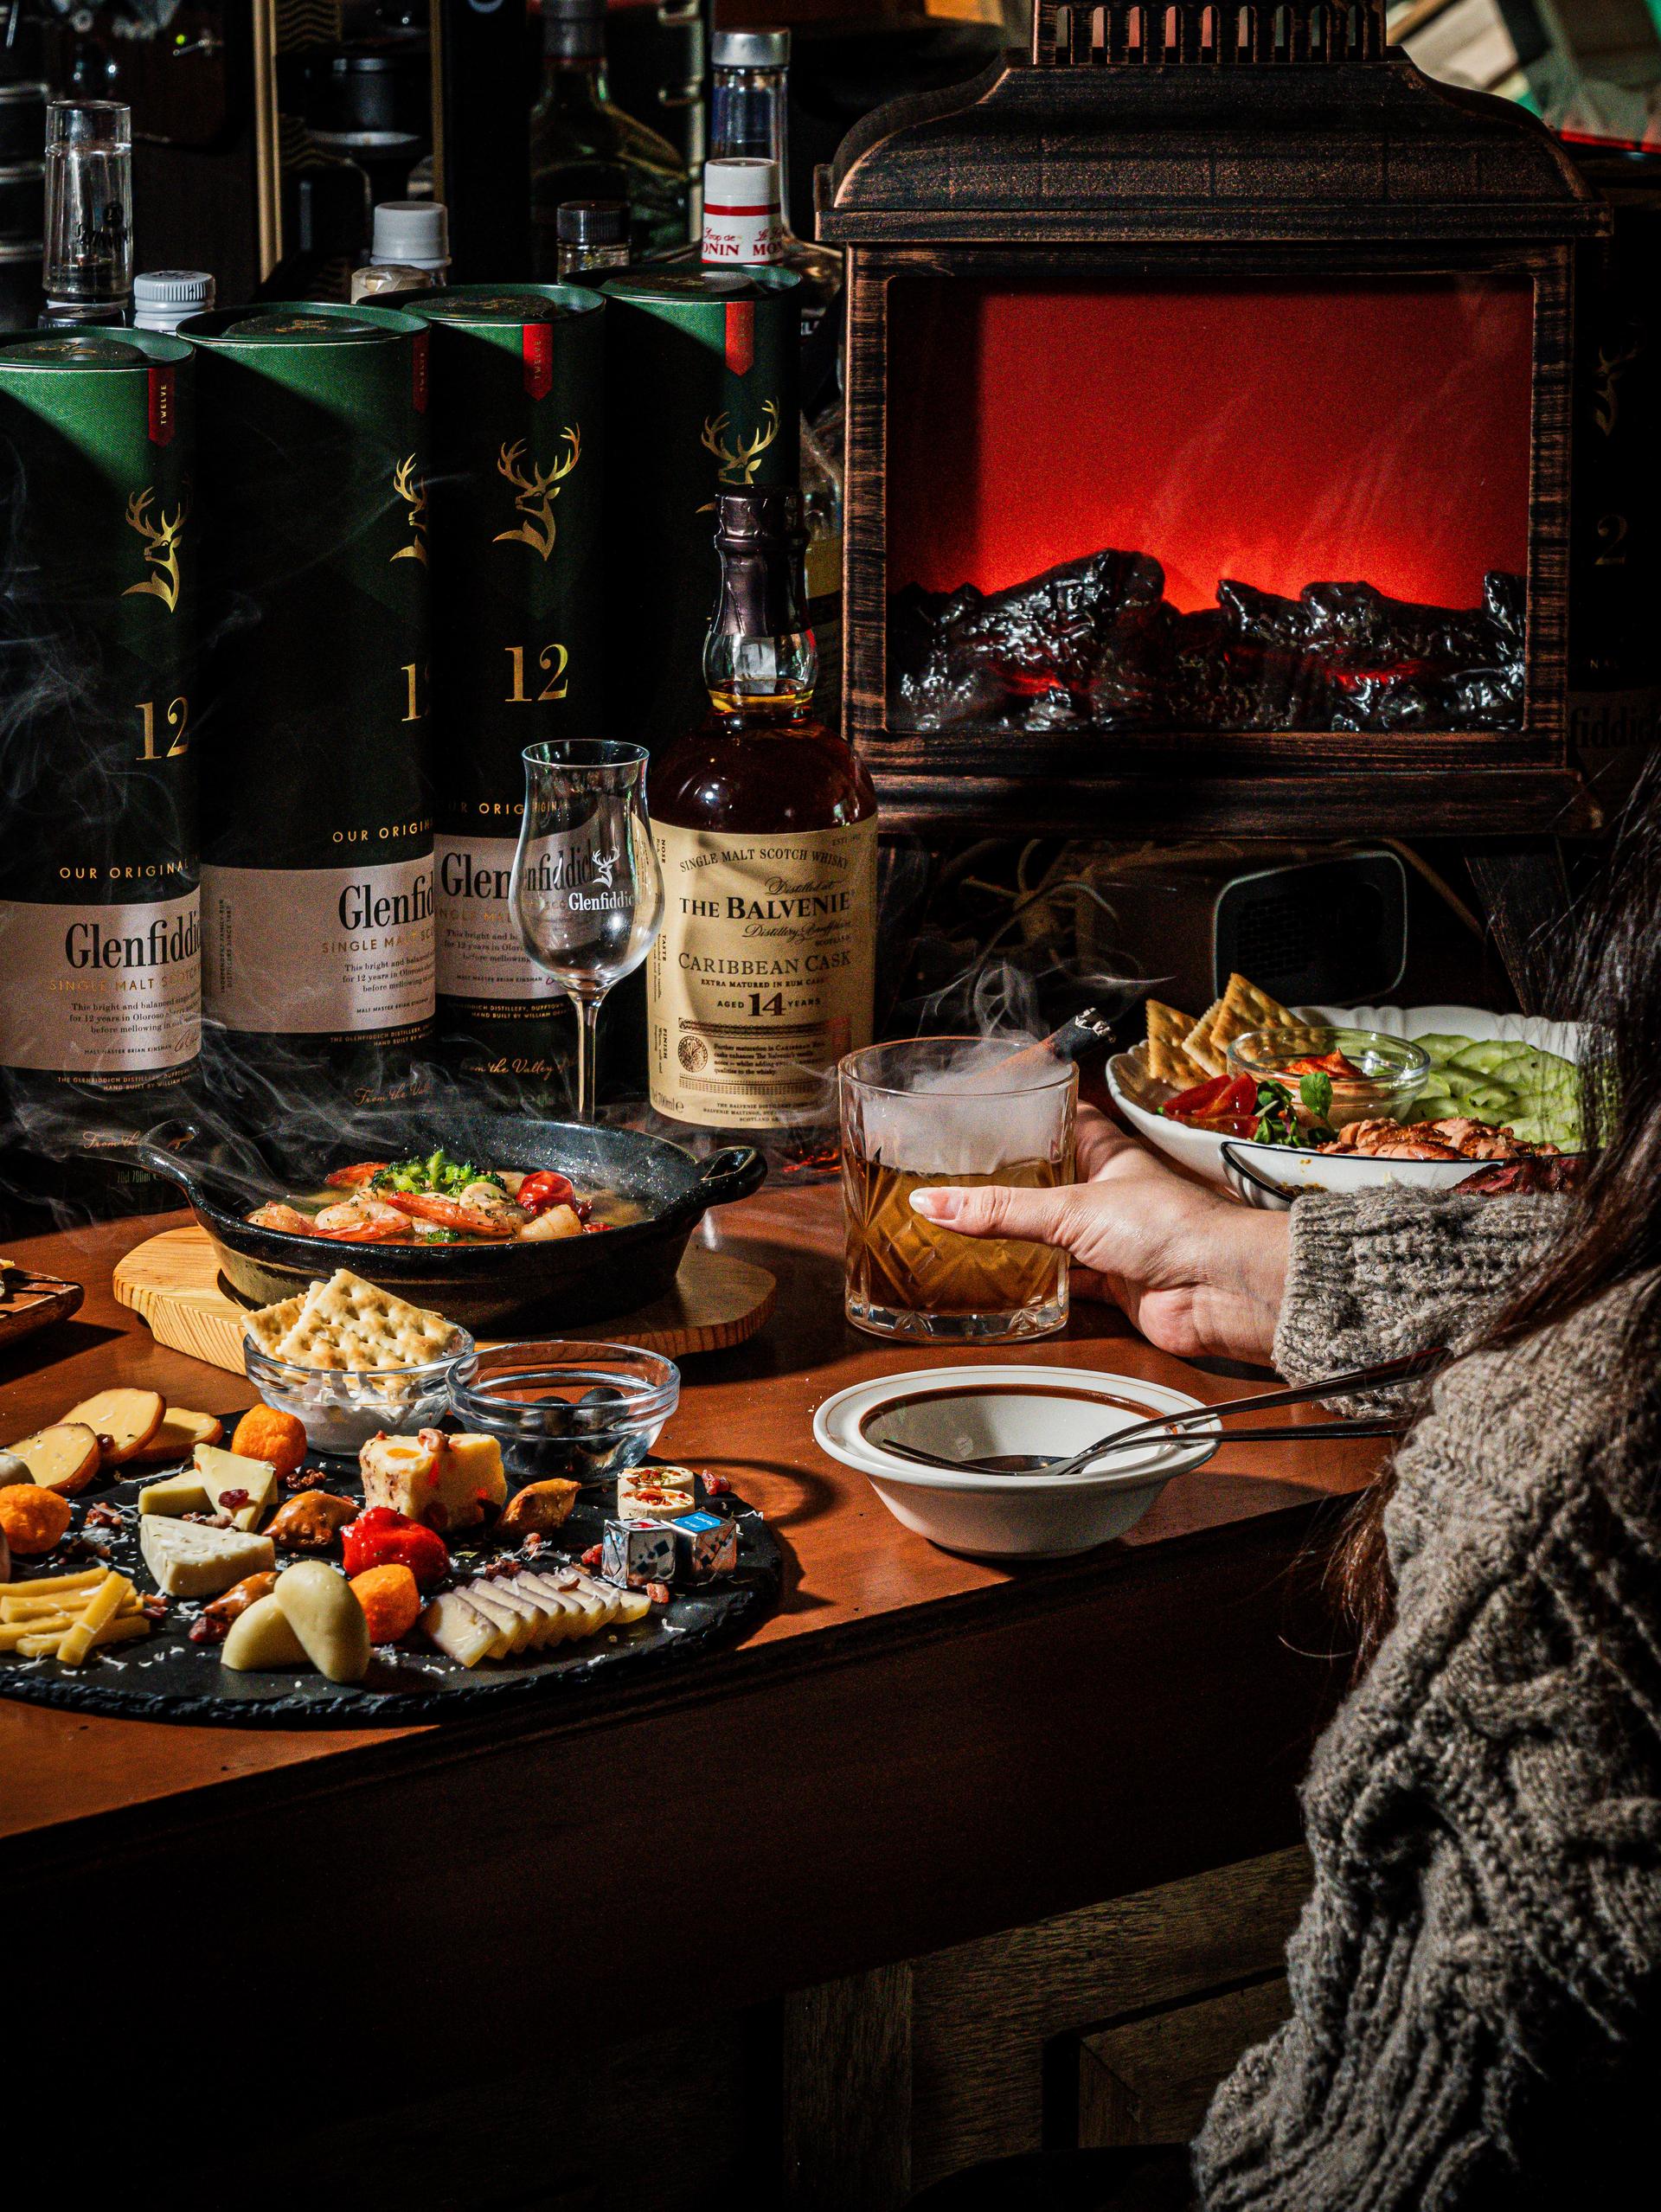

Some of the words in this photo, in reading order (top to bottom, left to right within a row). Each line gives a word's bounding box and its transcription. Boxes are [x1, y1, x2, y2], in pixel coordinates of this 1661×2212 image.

[701, 242, 740, 256] ONIN
[1593, 516, 1629, 567] 2
[503, 643, 569, 703] 12
[401, 663, 430, 721] 1
[134, 696, 189, 761] 12
[332, 830, 369, 843] OUR
[379, 819, 430, 839] ORIGIN
[60, 867, 97, 879] OUR
[110, 858, 189, 879] ORIGINAL
[680, 852, 718, 873] SINGLE
[721, 849, 755, 863] MALT
[760, 849, 808, 862] SCOTCH
[810, 850, 848, 870] WHISKY
[338, 869, 433, 931] Glenfid
[568, 890, 638, 912] Glenfiddic
[679, 896, 720, 918] THE
[726, 891, 850, 920] BALVENIE
[322, 939, 377, 953] SINGLE
[344, 964, 363, 972] This
[364, 959, 388, 972] bright
[391, 959, 405, 968] and
[678, 952, 799, 976] CARIBBEAN
[805, 950, 852, 972] CASK
[49, 979, 107, 991] SINGLE
[116, 978, 154, 991] MALT
[343, 975, 355, 984] for
[356, 974, 366, 983] 12
[367, 971, 389, 984] years
[390, 970, 398, 978] in
[701, 978, 727, 987] EXTRA
[728, 979, 770, 989] MATURED
[786, 978, 804, 987] RUM
[362, 984, 388, 993] before
[93, 1002, 119, 1013] bright
[122, 1002, 138, 1010] and
[716, 999, 745, 1009] AGED
[747, 991, 787, 1016] 14
[787, 997, 821, 1008] YEARS
[120, 1021, 162, 1034] mellowing
[122, 1013, 131, 1022] in
[132, 1012, 164, 1022] Oloroso
[147, 1044, 172, 1053] KINSMAN
[487, 1056, 510, 1074] the
[511, 1057, 554, 1080] Valley
[355, 1087, 388, 1108] From
[389, 1082, 407, 1101] the
[83, 1131, 119, 1150] From
